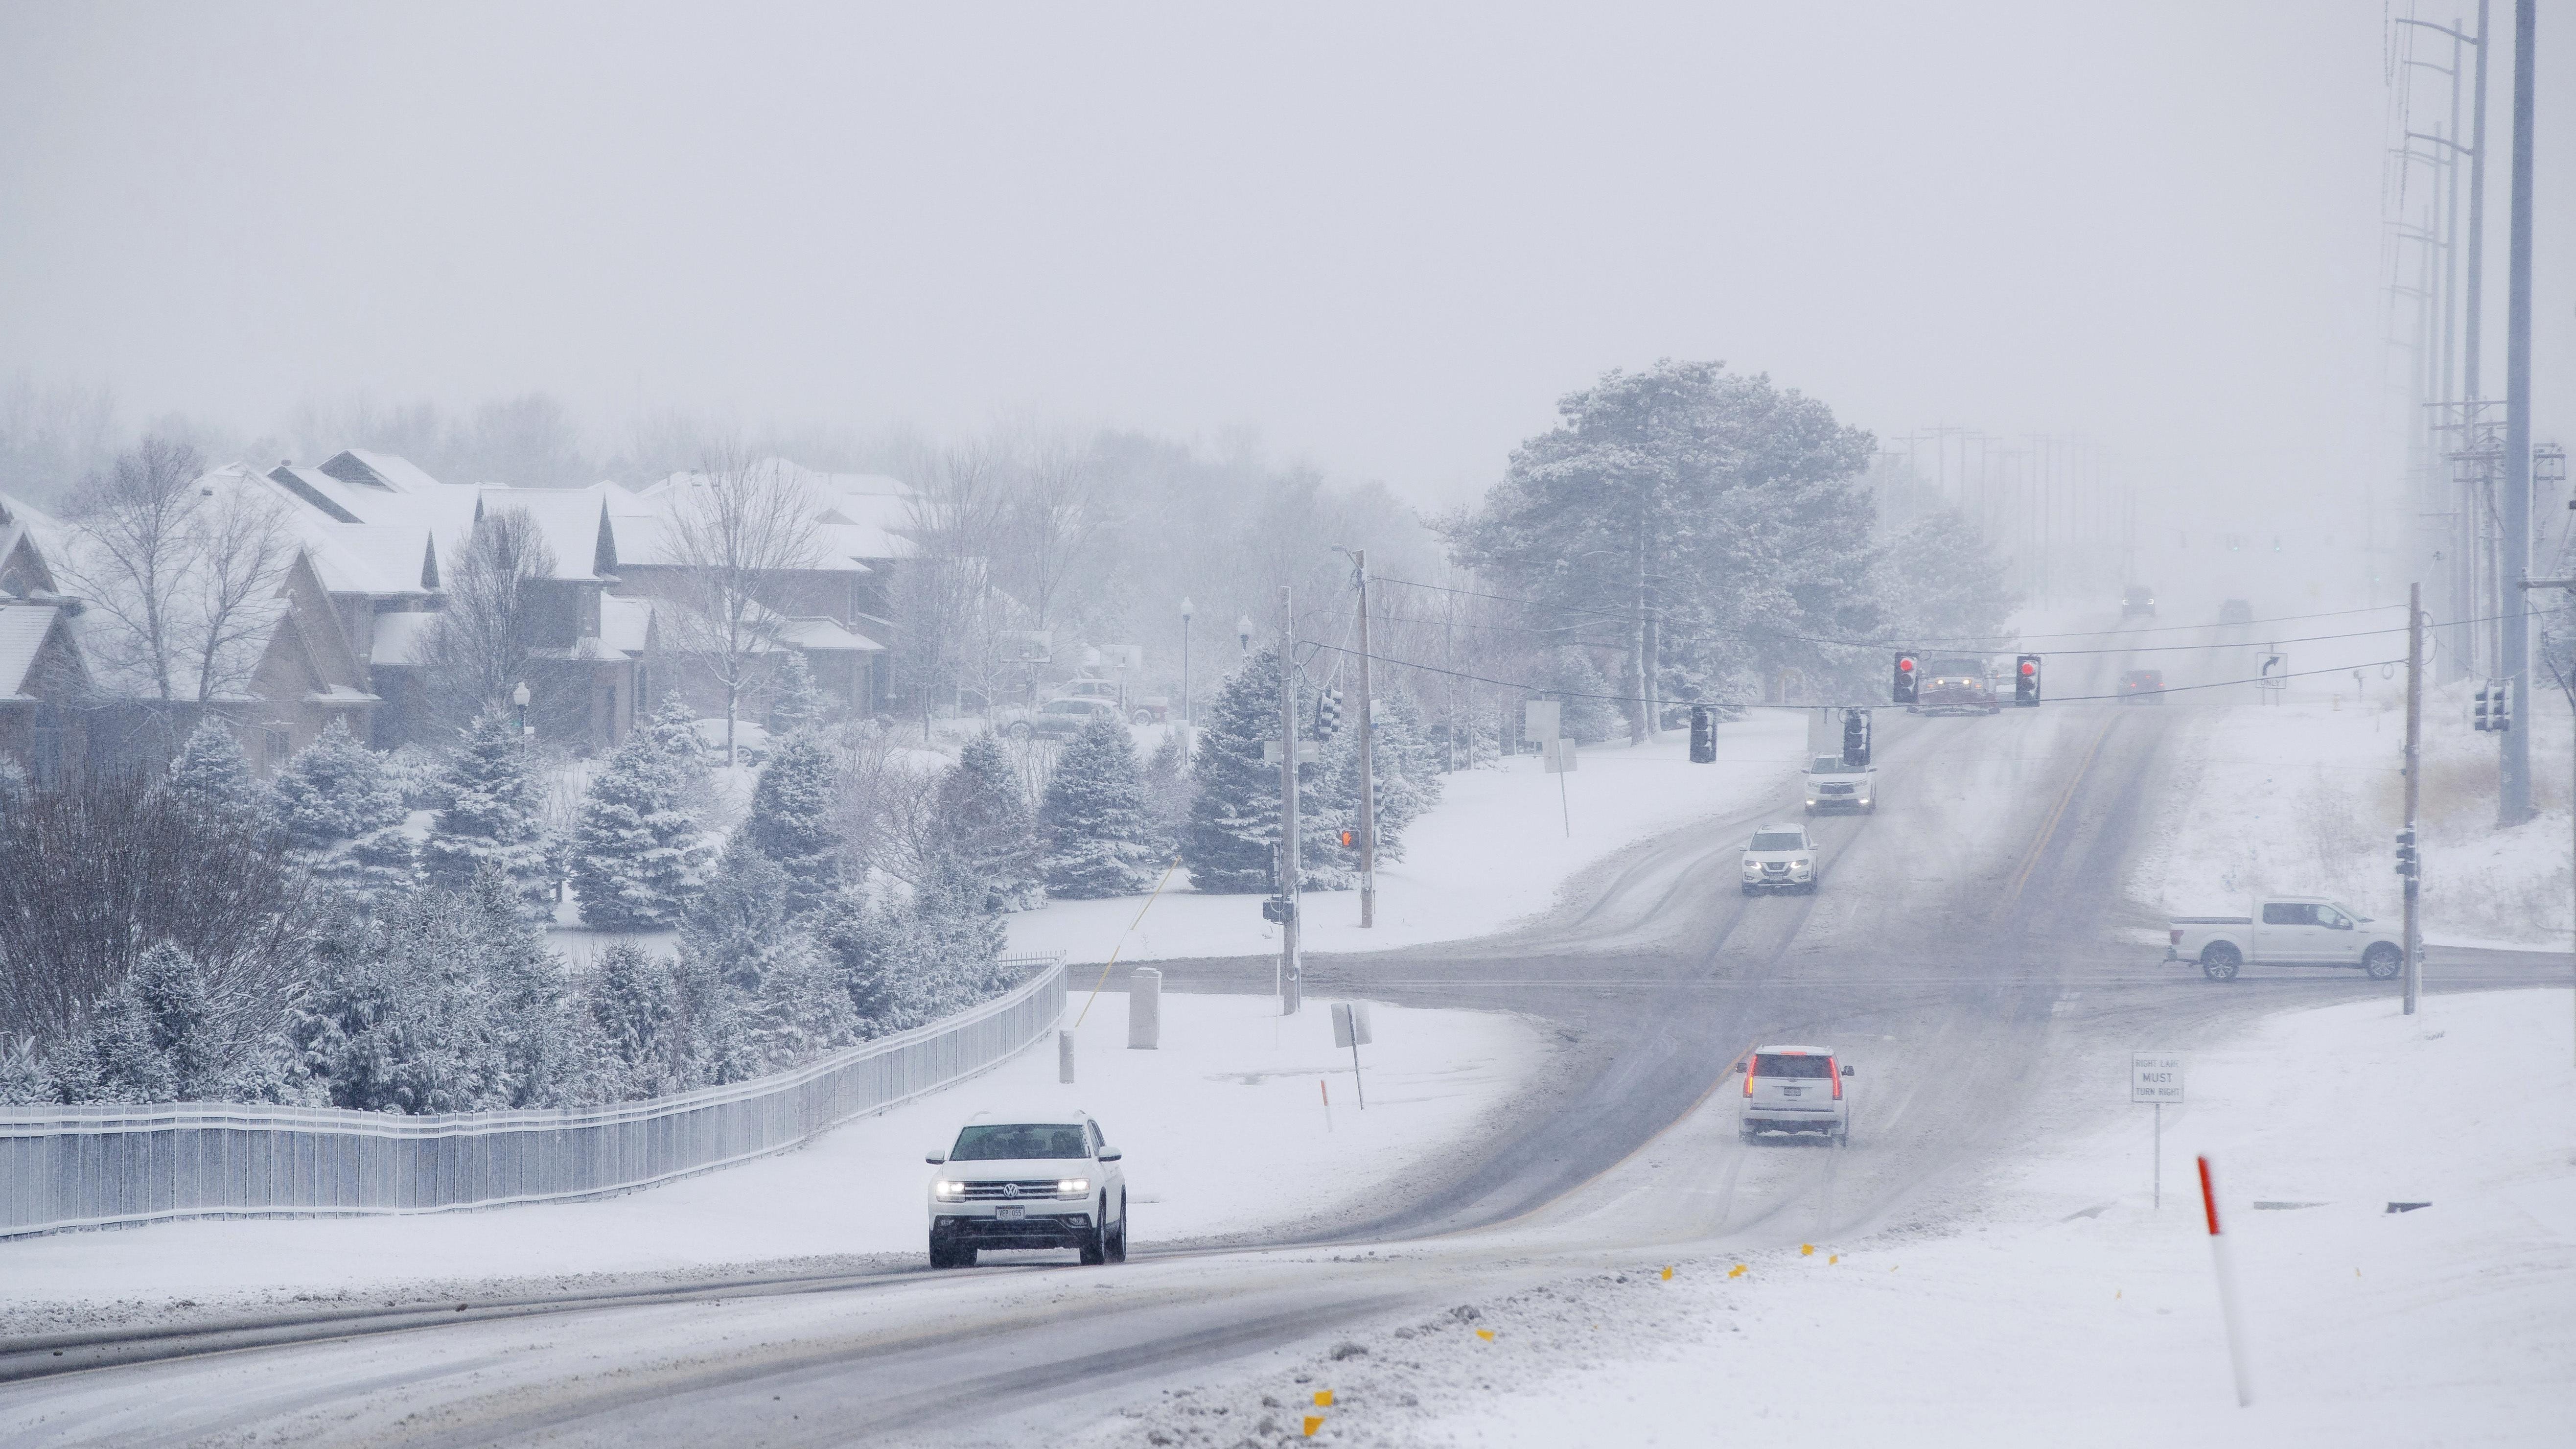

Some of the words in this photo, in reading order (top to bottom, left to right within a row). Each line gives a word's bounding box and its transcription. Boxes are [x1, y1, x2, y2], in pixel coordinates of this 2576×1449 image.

[2143, 1073, 2173, 1082] MUST
[2135, 1087, 2155, 1096] TURN
[2158, 1087, 2180, 1096] RIGHT
